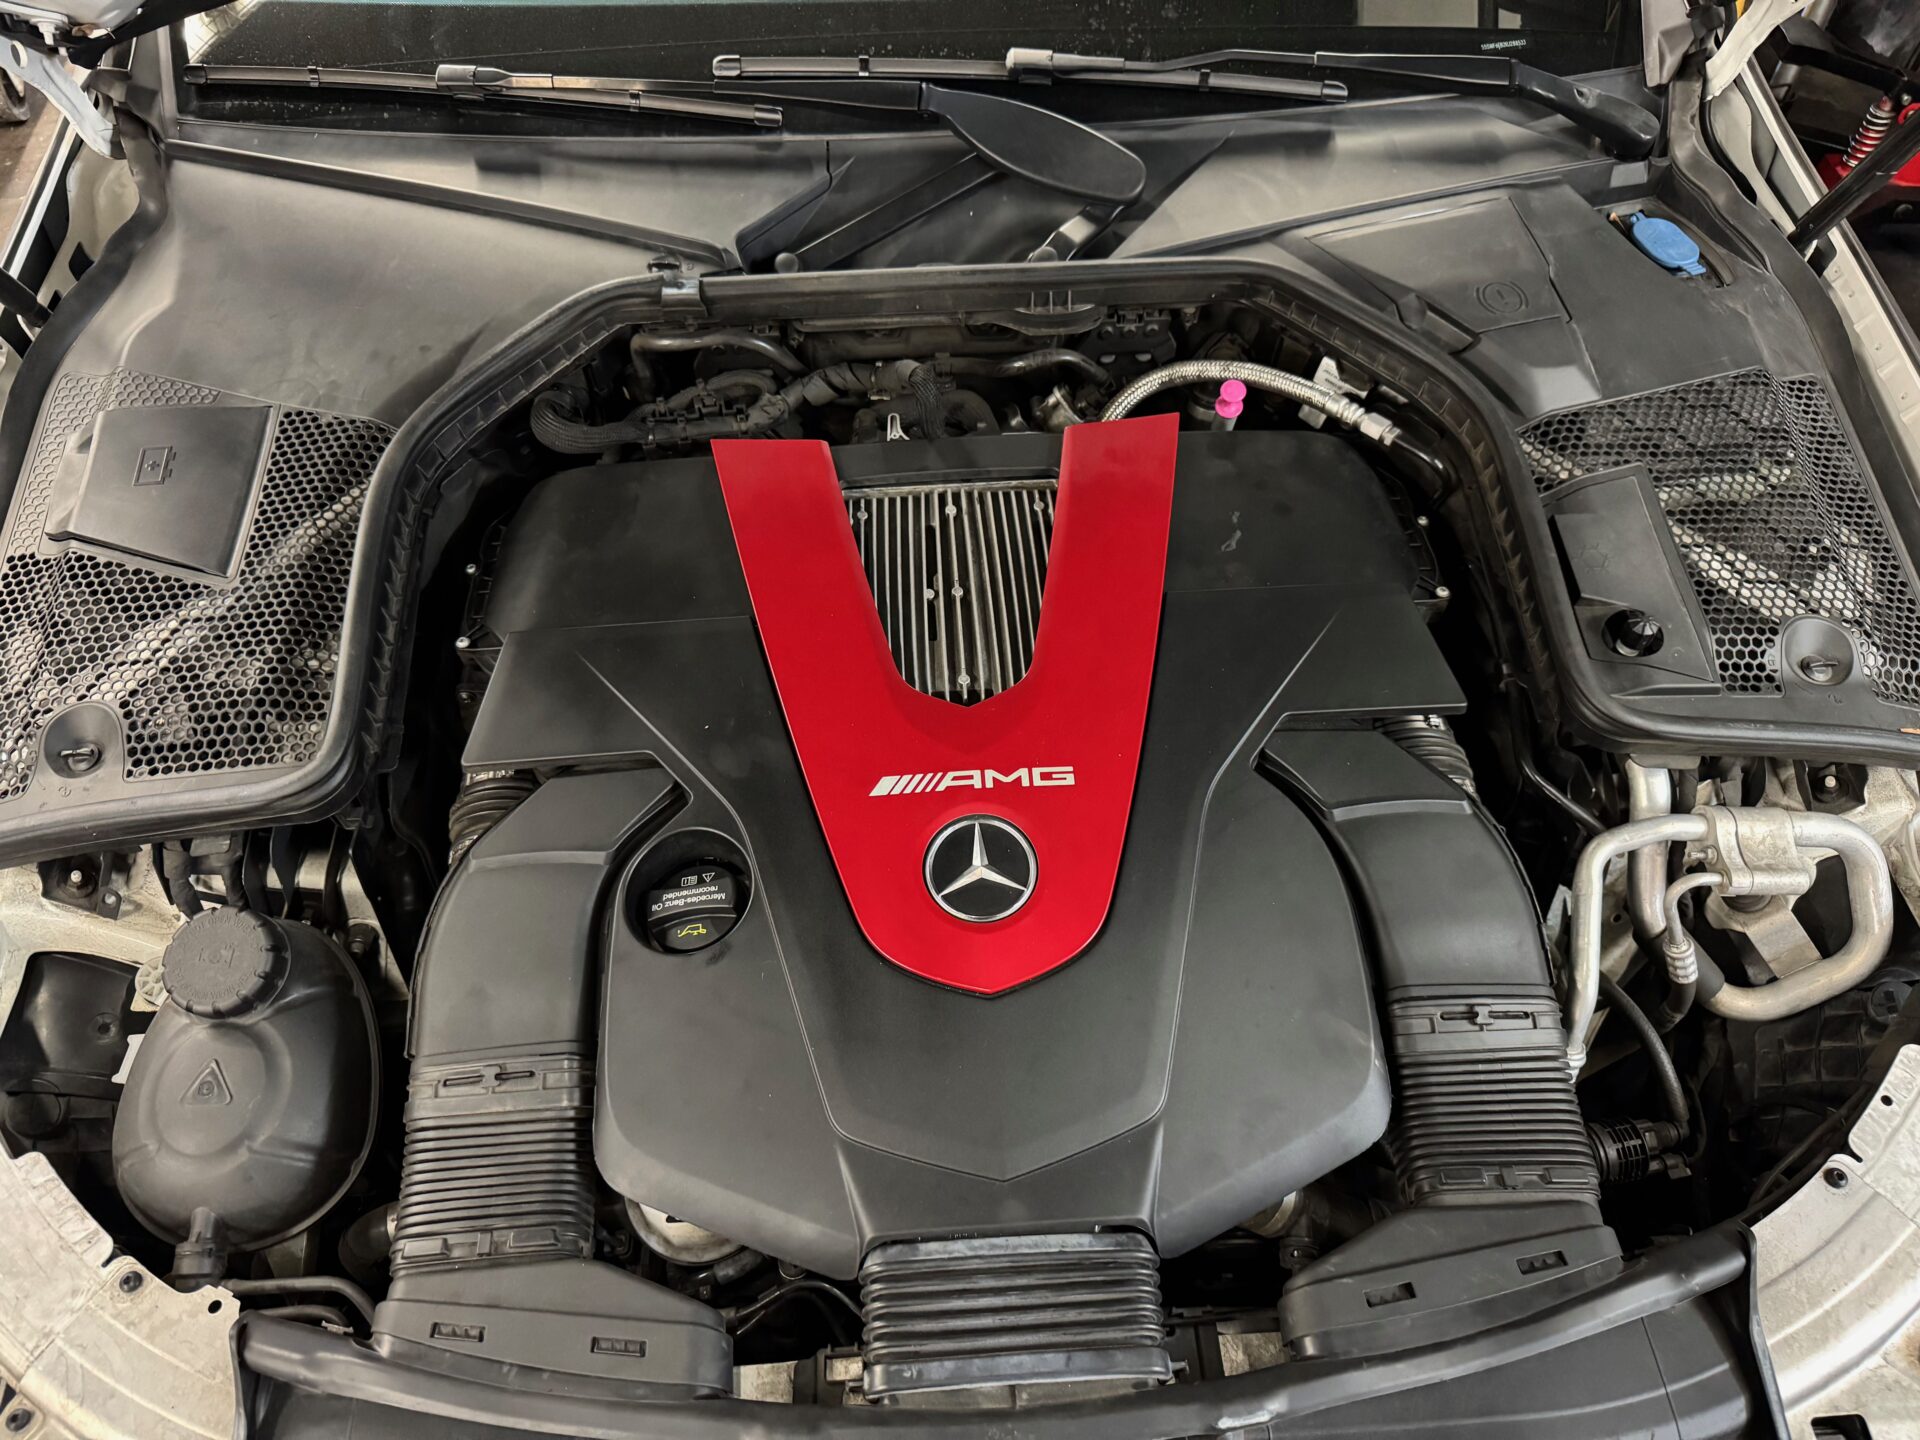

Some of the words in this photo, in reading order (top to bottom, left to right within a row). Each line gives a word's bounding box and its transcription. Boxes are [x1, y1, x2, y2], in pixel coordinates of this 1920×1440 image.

[936, 766, 1075, 791] AMG
[662, 885, 718, 901] recommended
[664, 892, 726, 907] Mercedes-Benz
[651, 902, 663, 912] Oil
